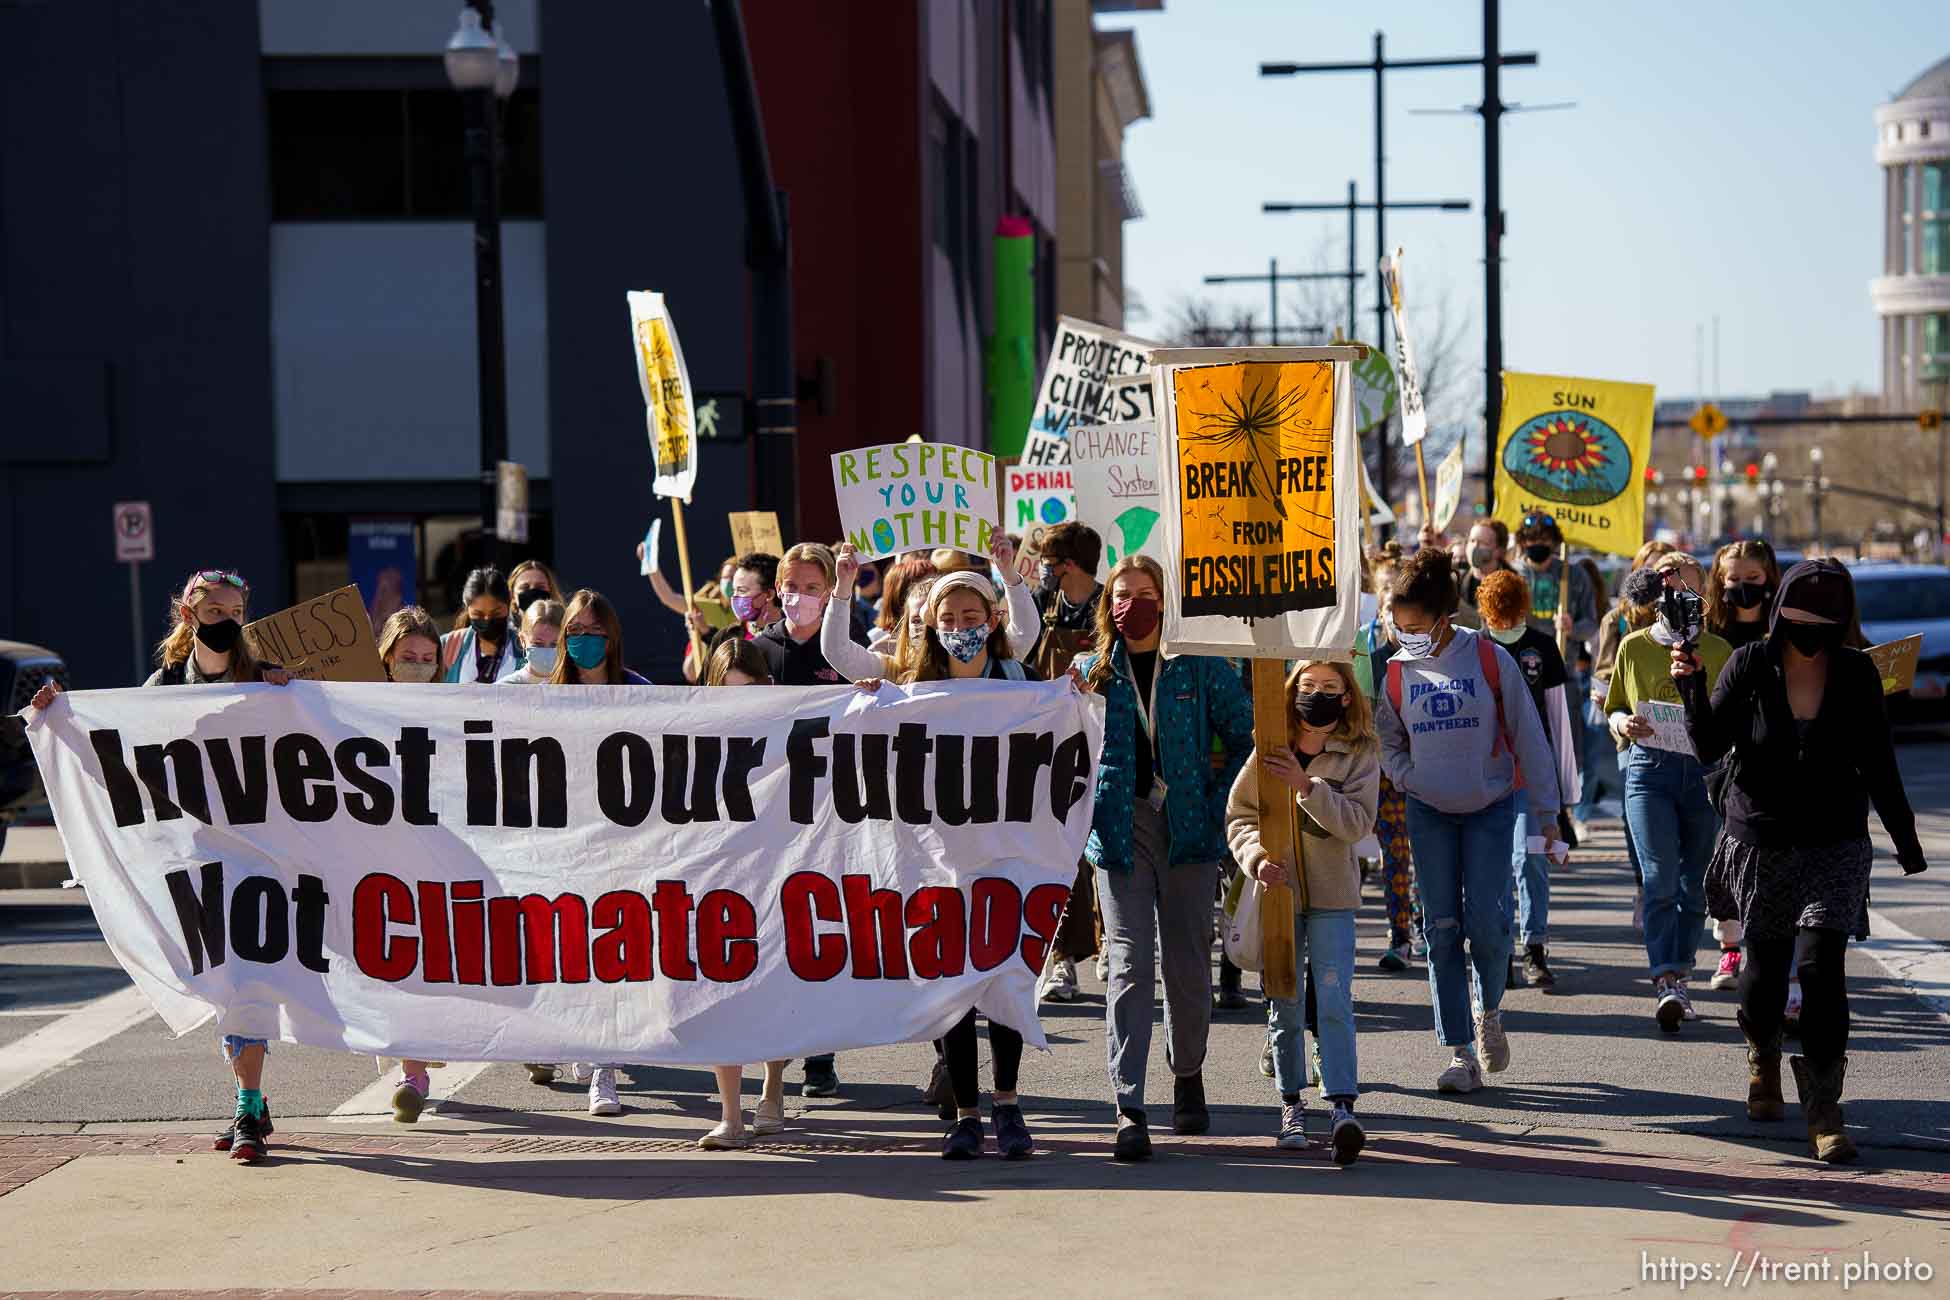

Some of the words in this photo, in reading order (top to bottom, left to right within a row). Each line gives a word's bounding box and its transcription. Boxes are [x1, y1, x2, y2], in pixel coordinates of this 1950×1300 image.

[1059, 331, 1147, 376] PROTECT
[1050, 374, 1119, 422] CLIMA
[1553, 391, 1596, 409] SUN
[1075, 429, 1150, 459] CHANGE
[839, 445, 993, 488] RESPECT
[1011, 470, 1074, 493] DENIAL
[1185, 460, 1257, 499] BREAK
[1275, 455, 1328, 495] FREE
[878, 481, 969, 509] YOUR
[1233, 521, 1283, 545] FROM
[1183, 555, 1261, 598] FOSSIL
[1263, 548, 1333, 597] FUELS
[253, 592, 357, 665] NLESS
[1412, 716, 1480, 735] PANTHERS
[90, 726, 439, 828] Invest
[464, 719, 568, 828] in
[597, 730, 767, 828] our
[786, 716, 1092, 826] Future
[166, 861, 331, 976] Not
[352, 871, 758, 985] Climate
